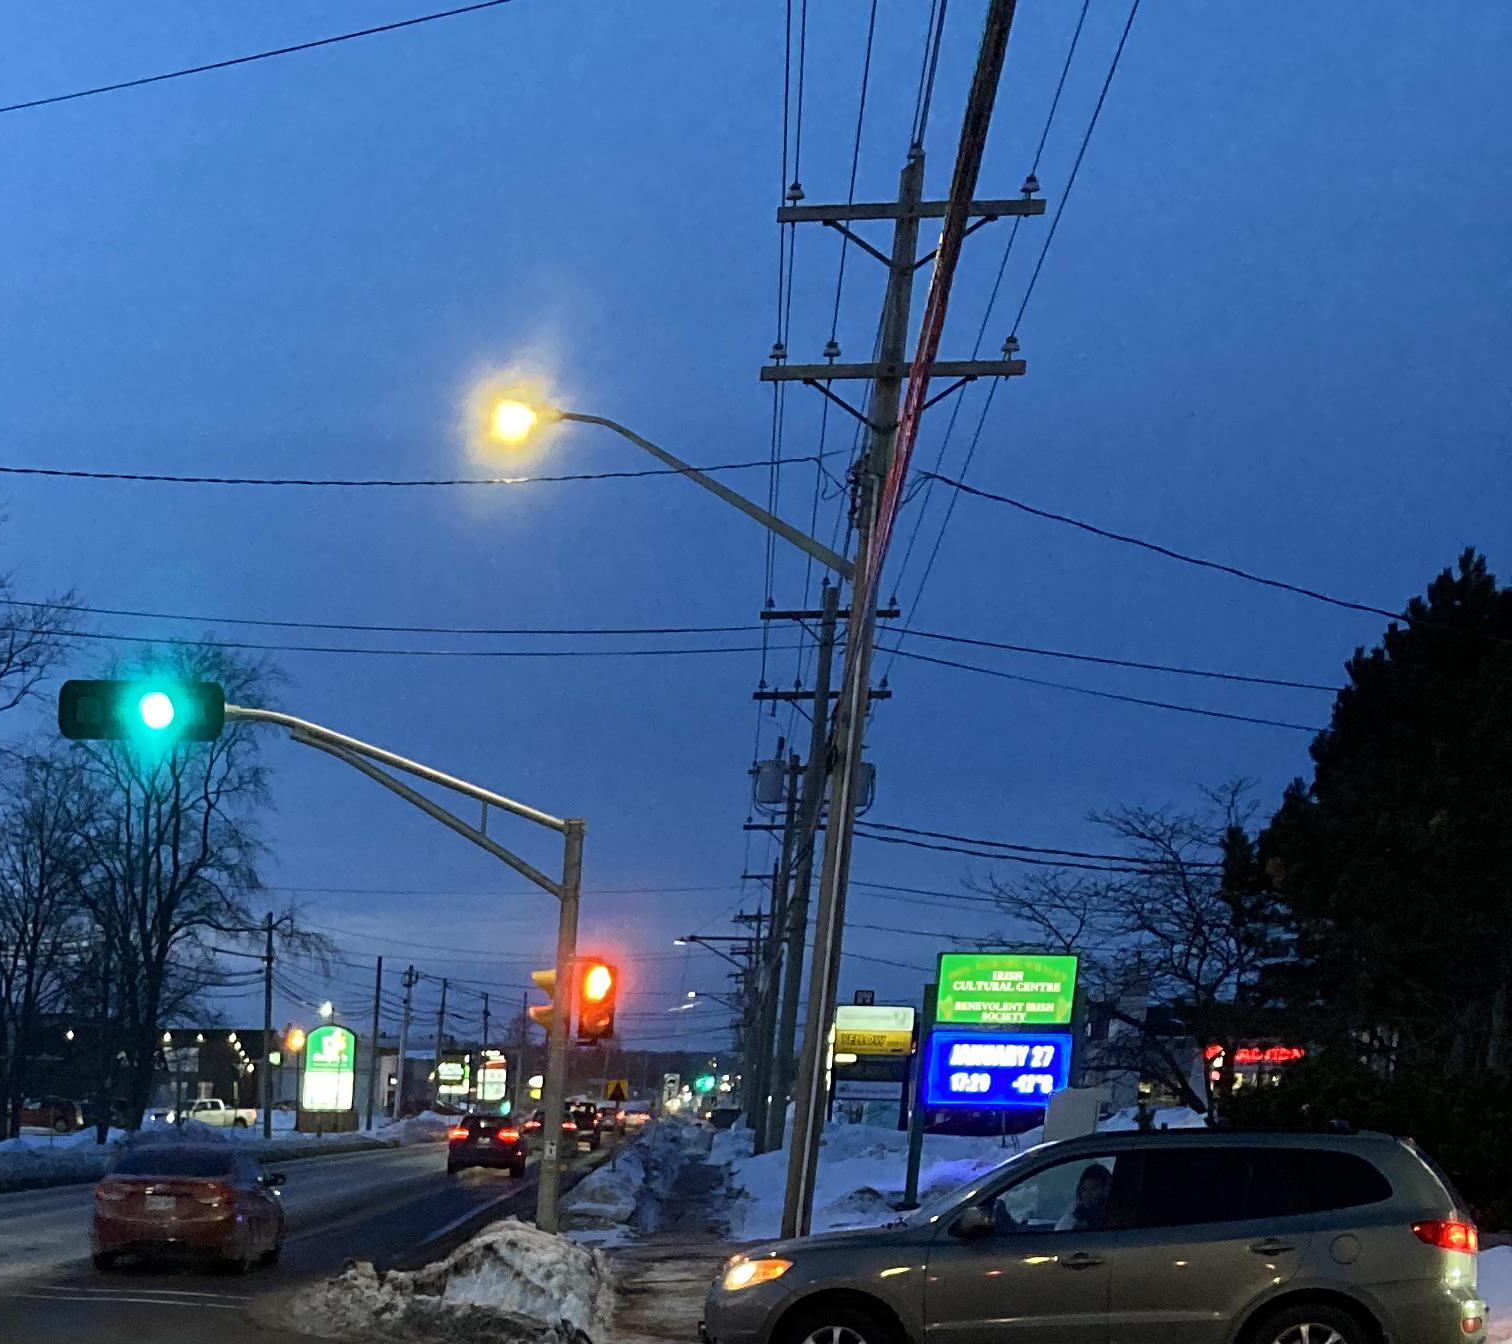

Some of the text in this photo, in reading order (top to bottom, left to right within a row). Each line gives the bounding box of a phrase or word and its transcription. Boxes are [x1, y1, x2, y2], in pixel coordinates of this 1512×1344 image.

[992, 971, 1024, 981] IRISH
[952, 981, 1061, 993] CULTURAL CENTRE
[954, 1001, 1055, 1013] BENEVOLENT IRISH
[981, 1012, 1026, 1023] SOCIETY
[949, 1043, 1055, 1068] JANUARY 27
